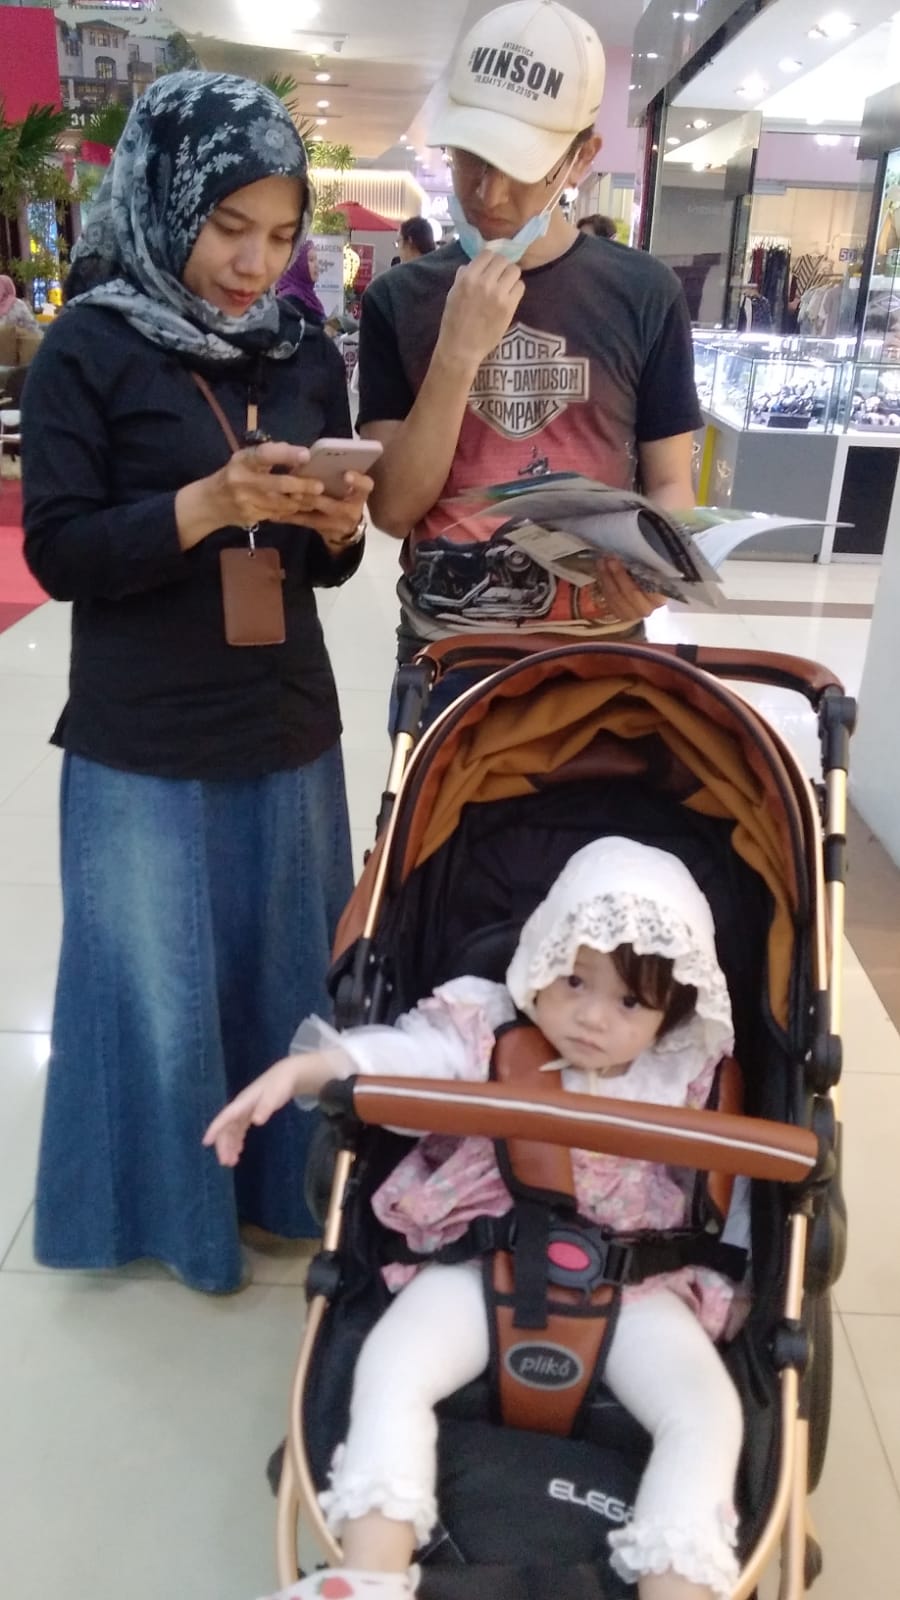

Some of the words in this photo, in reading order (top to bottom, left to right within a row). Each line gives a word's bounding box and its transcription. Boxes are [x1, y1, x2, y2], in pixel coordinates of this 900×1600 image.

[502, 41, 534, 57] ANTARCTICA
[471, 47, 564, 100] VINSON
[70, 113, 85, 127] 31
[470, 367, 579, 393] ARLEY-DAVIDSON
[488, 399, 549, 430] COMPANY
